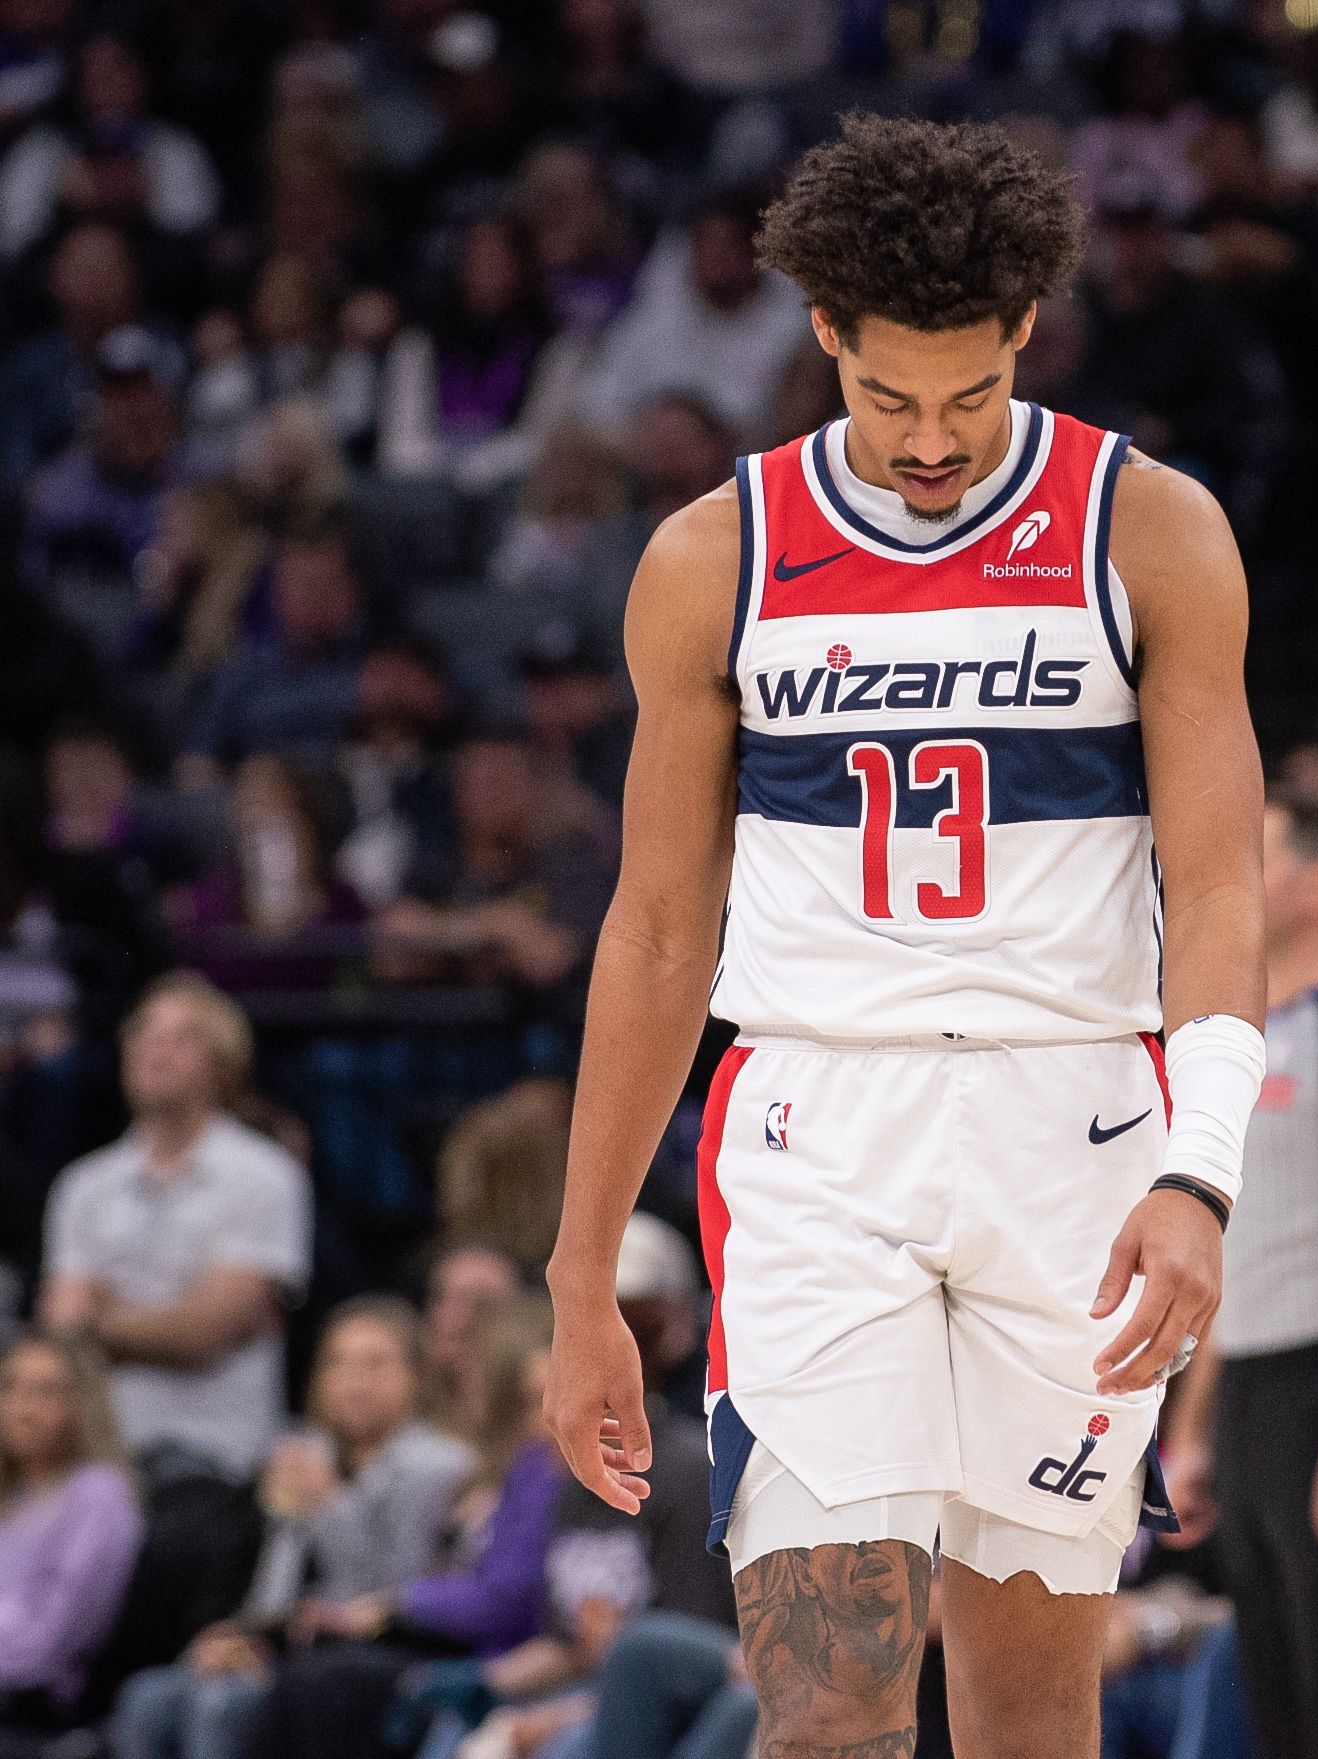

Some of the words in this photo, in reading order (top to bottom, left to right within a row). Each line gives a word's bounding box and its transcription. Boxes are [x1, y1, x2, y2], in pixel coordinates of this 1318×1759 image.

[983, 562, 1072, 578] Robinhood
[756, 628, 1091, 720] wizards
[846, 738, 990, 925] 13
